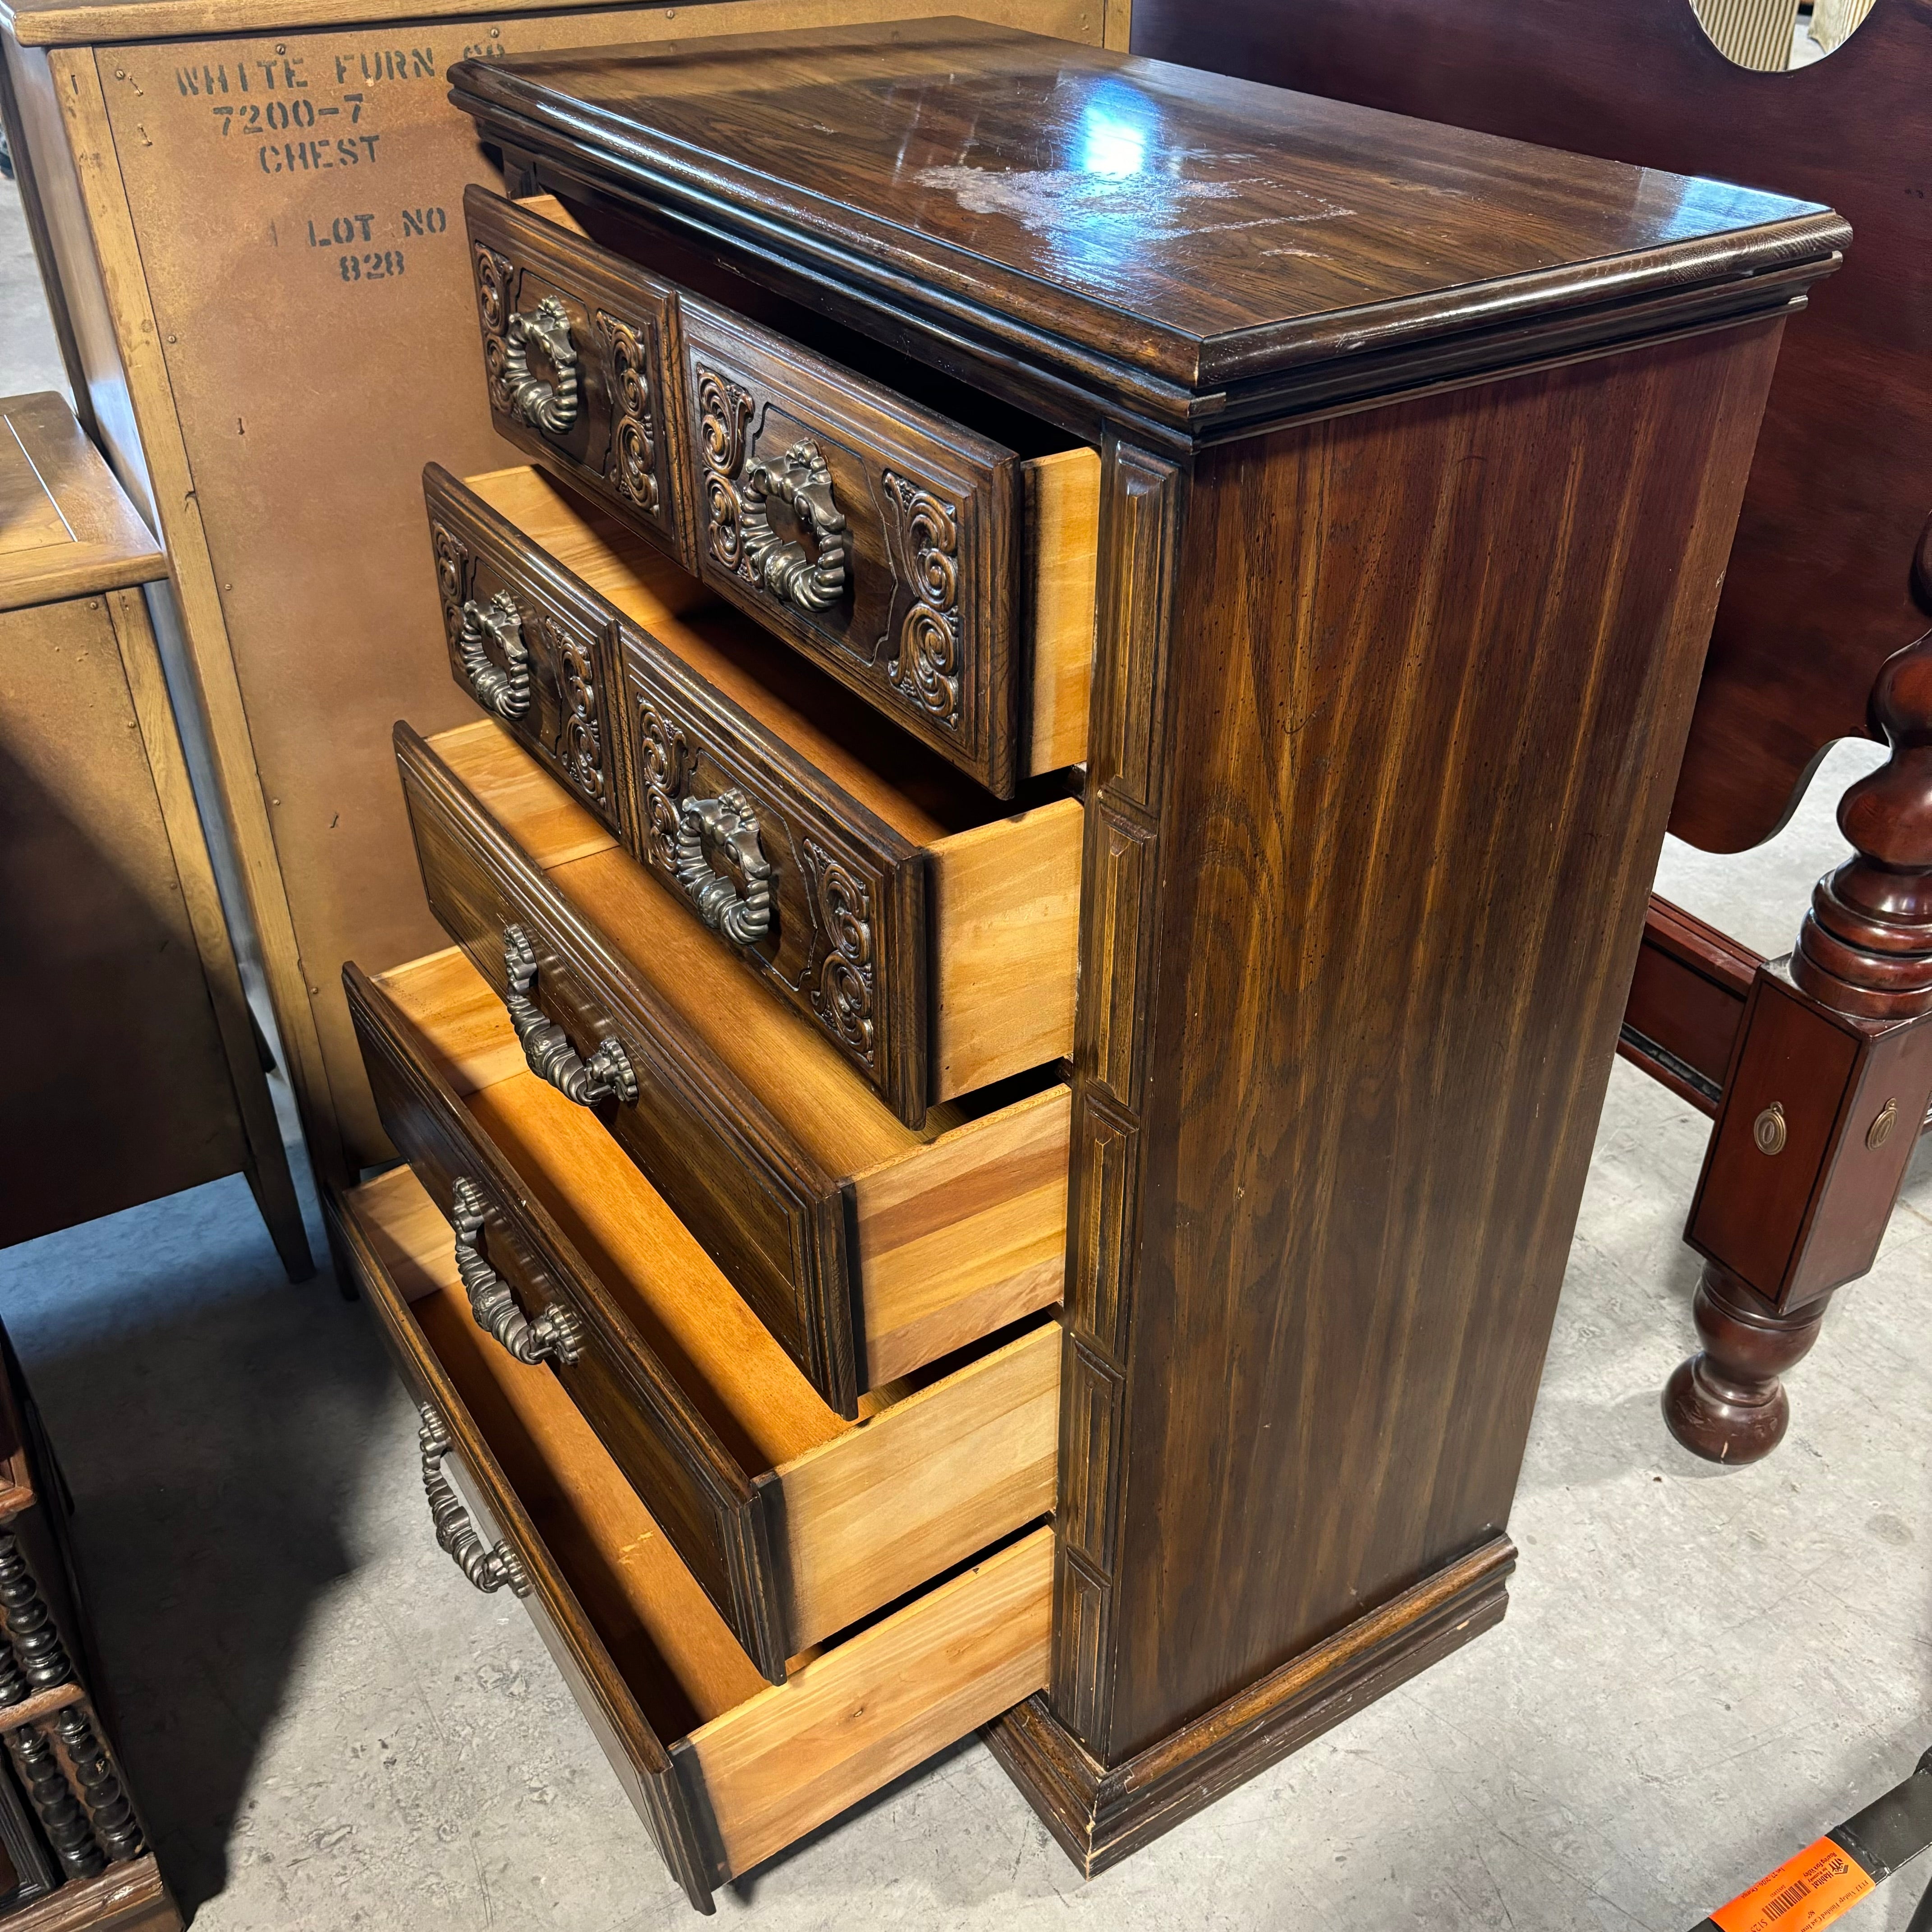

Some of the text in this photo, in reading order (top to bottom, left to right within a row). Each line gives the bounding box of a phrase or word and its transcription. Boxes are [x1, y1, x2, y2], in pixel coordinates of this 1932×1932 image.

[176, 58, 308, 96] WHITE
[335, 47, 435, 84] FURN
[213, 93, 363, 135] 7200-7
[259, 135, 380, 174] CHEST
[308, 207, 446, 247] LOT NO
[340, 250, 405, 281] 828
[1811, 1871, 1834, 1889] Habitat
